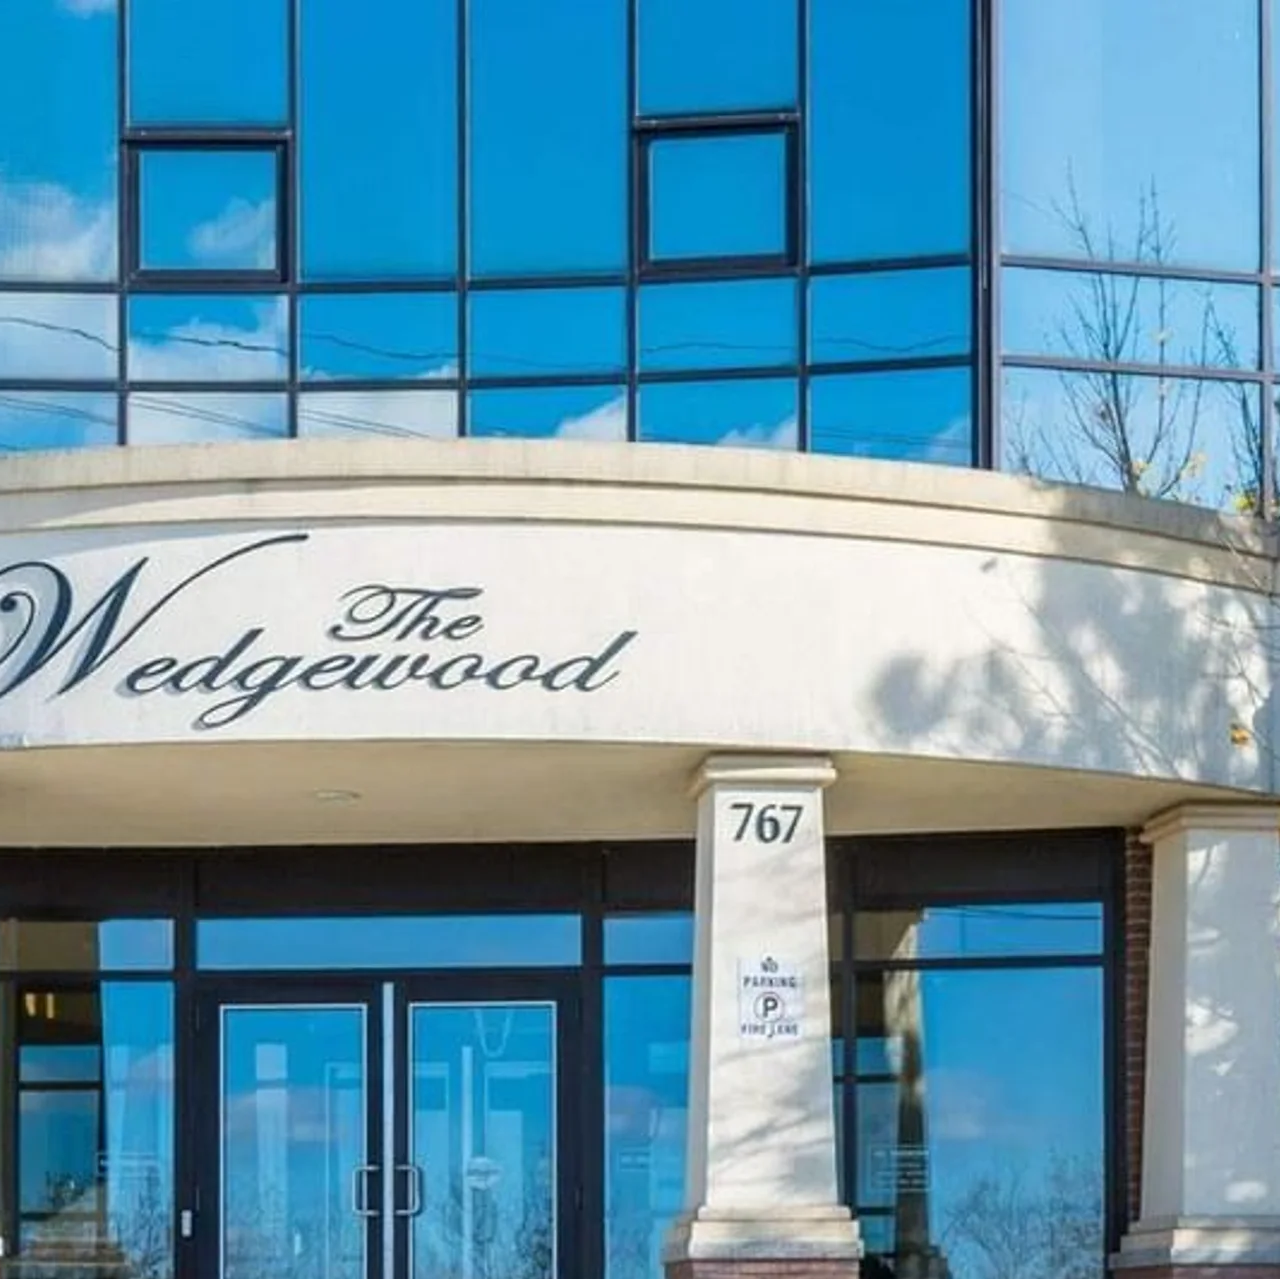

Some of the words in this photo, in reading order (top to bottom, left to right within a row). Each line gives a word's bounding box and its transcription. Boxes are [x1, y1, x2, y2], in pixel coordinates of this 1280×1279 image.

[328, 584, 485, 642] The
[729, 803, 804, 844] 767
[761, 961, 779, 973] NO
[743, 975, 797, 989] PARKING
[762, 996, 778, 1018] P
